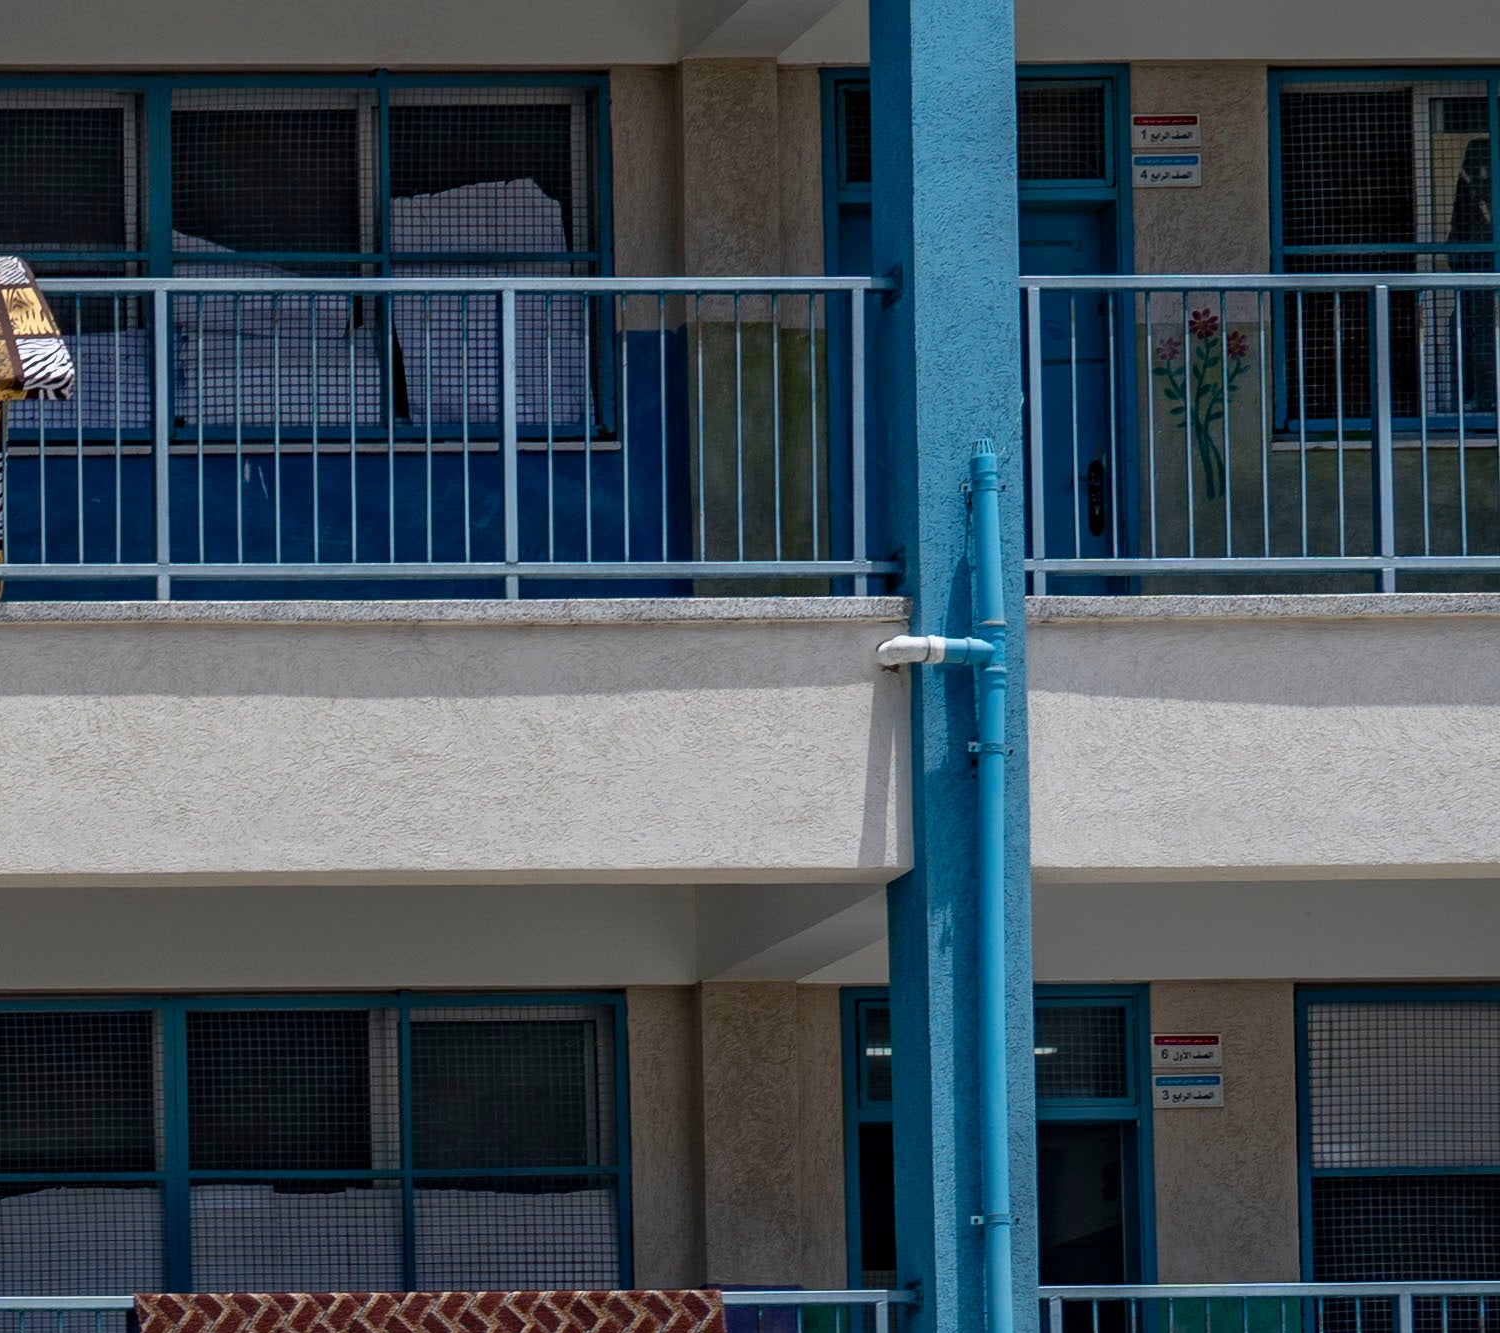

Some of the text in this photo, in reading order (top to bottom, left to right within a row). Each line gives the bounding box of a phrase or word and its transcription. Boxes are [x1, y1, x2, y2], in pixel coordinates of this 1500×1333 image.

[1141, 130, 1146, 140] 1
[1171, 130, 1192, 142] الصف
[1140, 170, 1147, 180] 4
[1171, 170, 1192, 182] الصف
[1161, 1050, 1168, 1059] 6
[1192, 1050, 1214, 1061] الصف
[1162, 1091, 1169, 1100] 3
[1192, 1091, 1214, 1102] الصف
